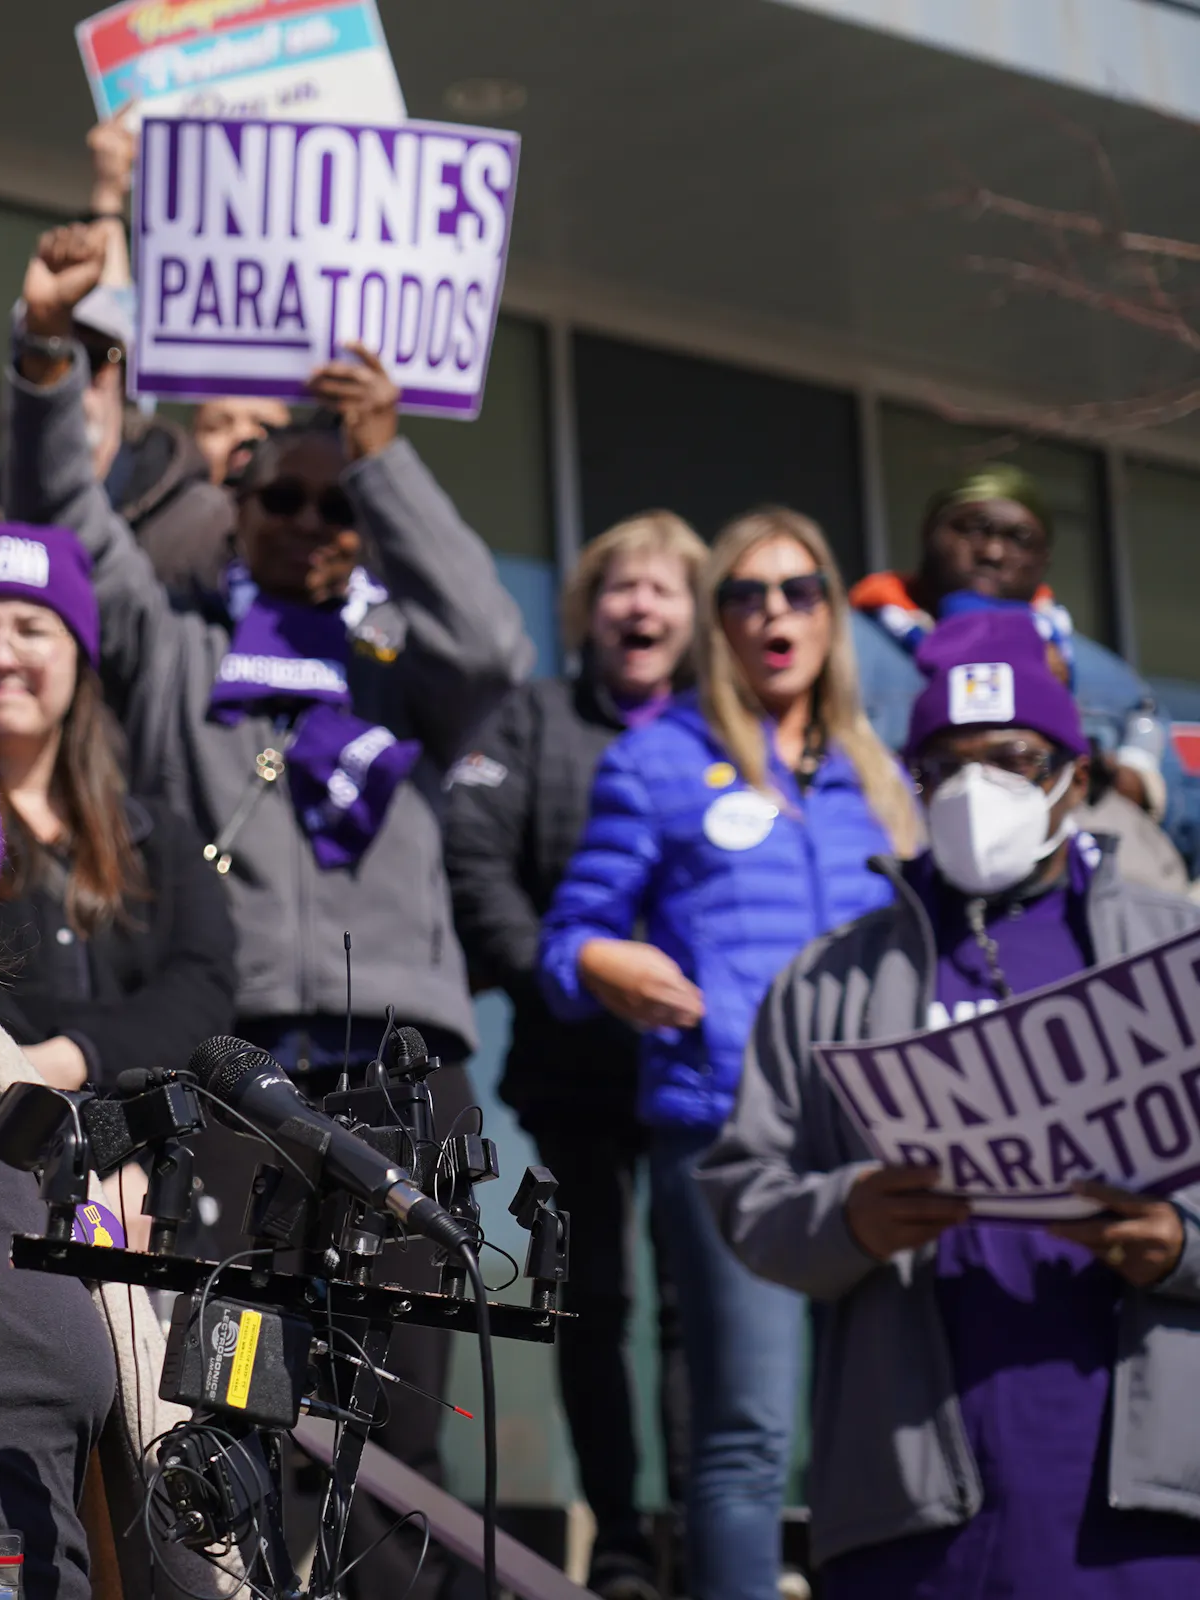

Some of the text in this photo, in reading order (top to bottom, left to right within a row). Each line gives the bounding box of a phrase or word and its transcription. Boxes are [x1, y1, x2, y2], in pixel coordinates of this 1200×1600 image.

[145, 122, 512, 256] UNIONES
[160, 257, 483, 371] PARA TODOS
[897, 1120, 1096, 1190] PARA
[209, 1308, 231, 1399] LECTROSONICS
